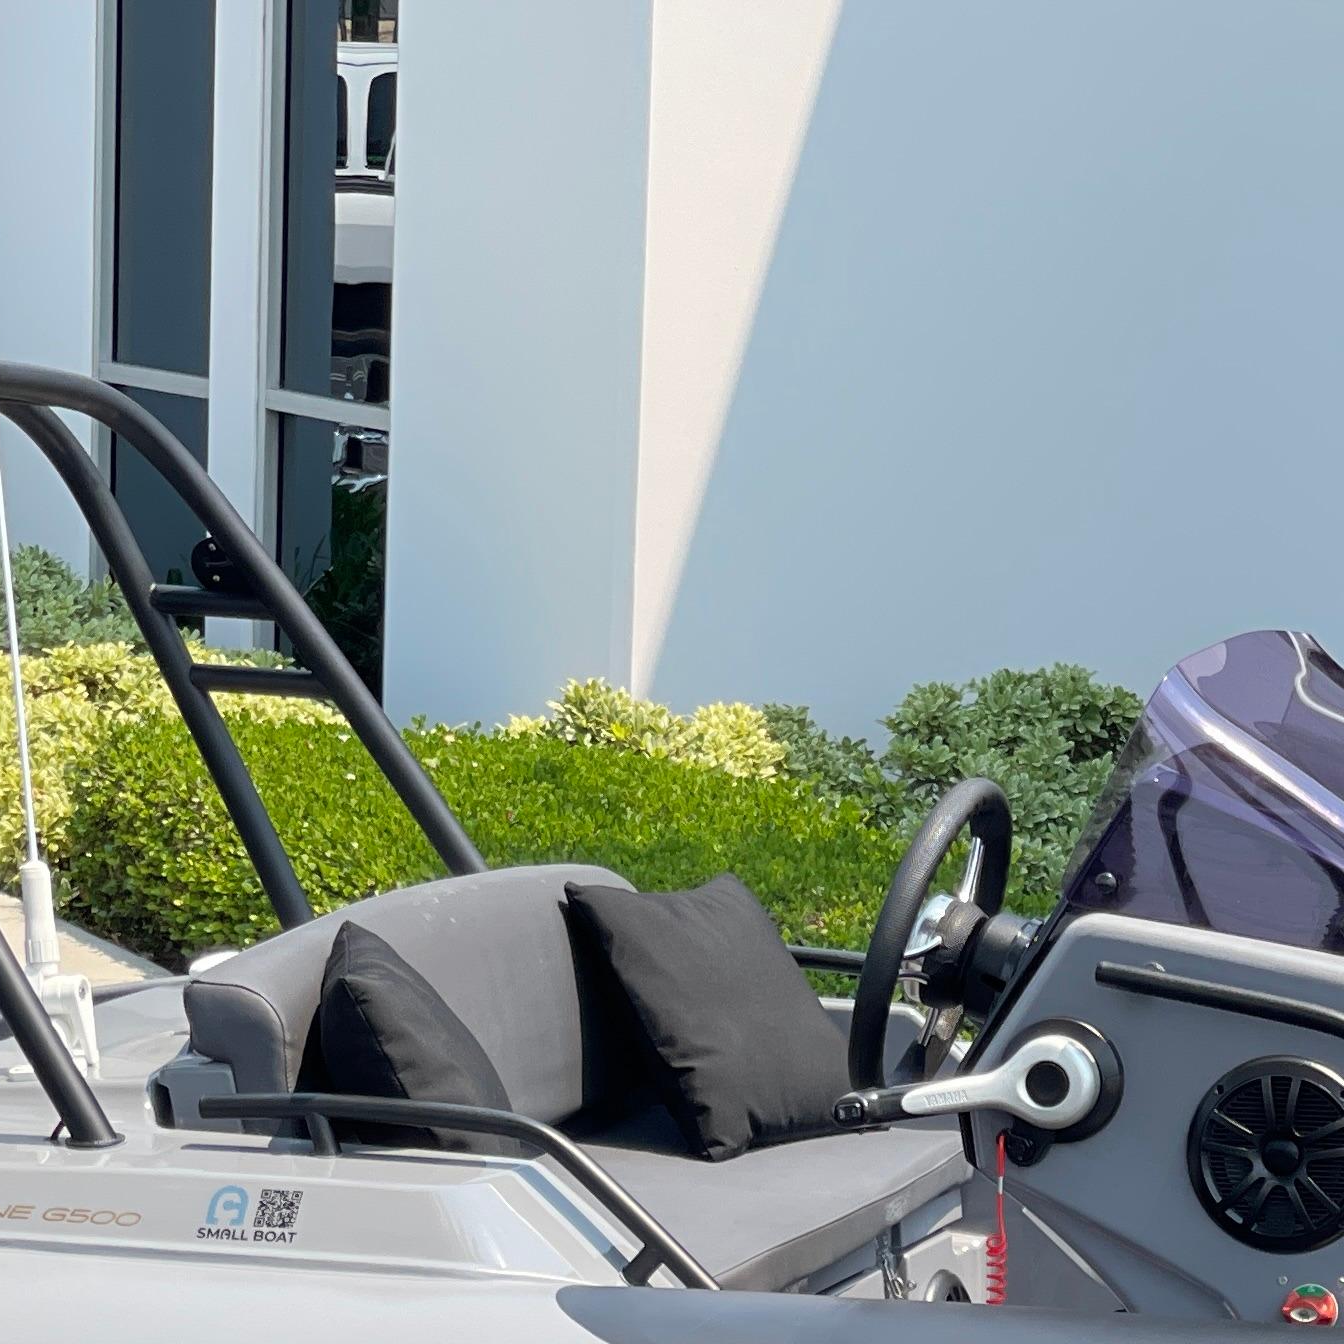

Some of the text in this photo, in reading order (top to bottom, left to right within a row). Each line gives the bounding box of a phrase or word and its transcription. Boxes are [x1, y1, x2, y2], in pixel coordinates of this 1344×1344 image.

[42, 1207, 141, 1227] G500
[196, 1226, 298, 1243] SMALL BOAT
